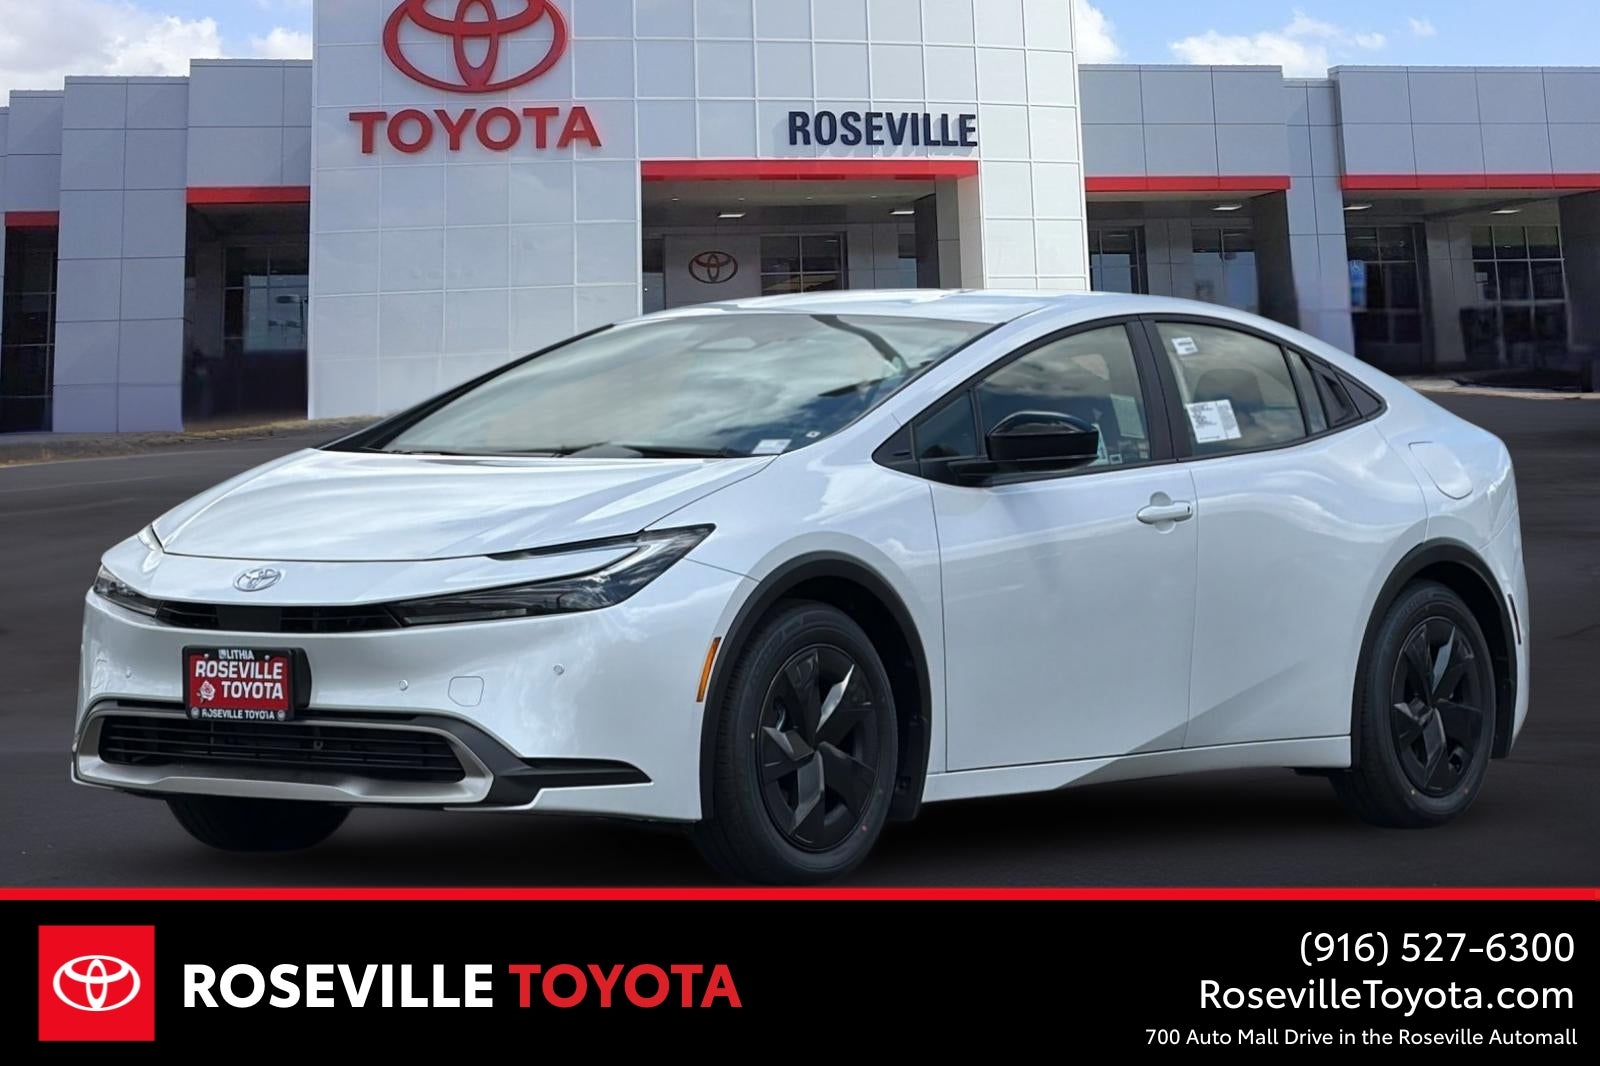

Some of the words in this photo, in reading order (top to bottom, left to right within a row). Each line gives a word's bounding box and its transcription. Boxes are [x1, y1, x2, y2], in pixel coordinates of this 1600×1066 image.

[349, 106, 602, 154] TOYOTA
[788, 111, 978, 147] ROSEVILLE
[226, 649, 254, 660] LITHIA
[195, 661, 283, 679] ROSEVILLE
[221, 681, 284, 699] TOYOTA
[245, 710, 275, 720] TOYOTA
